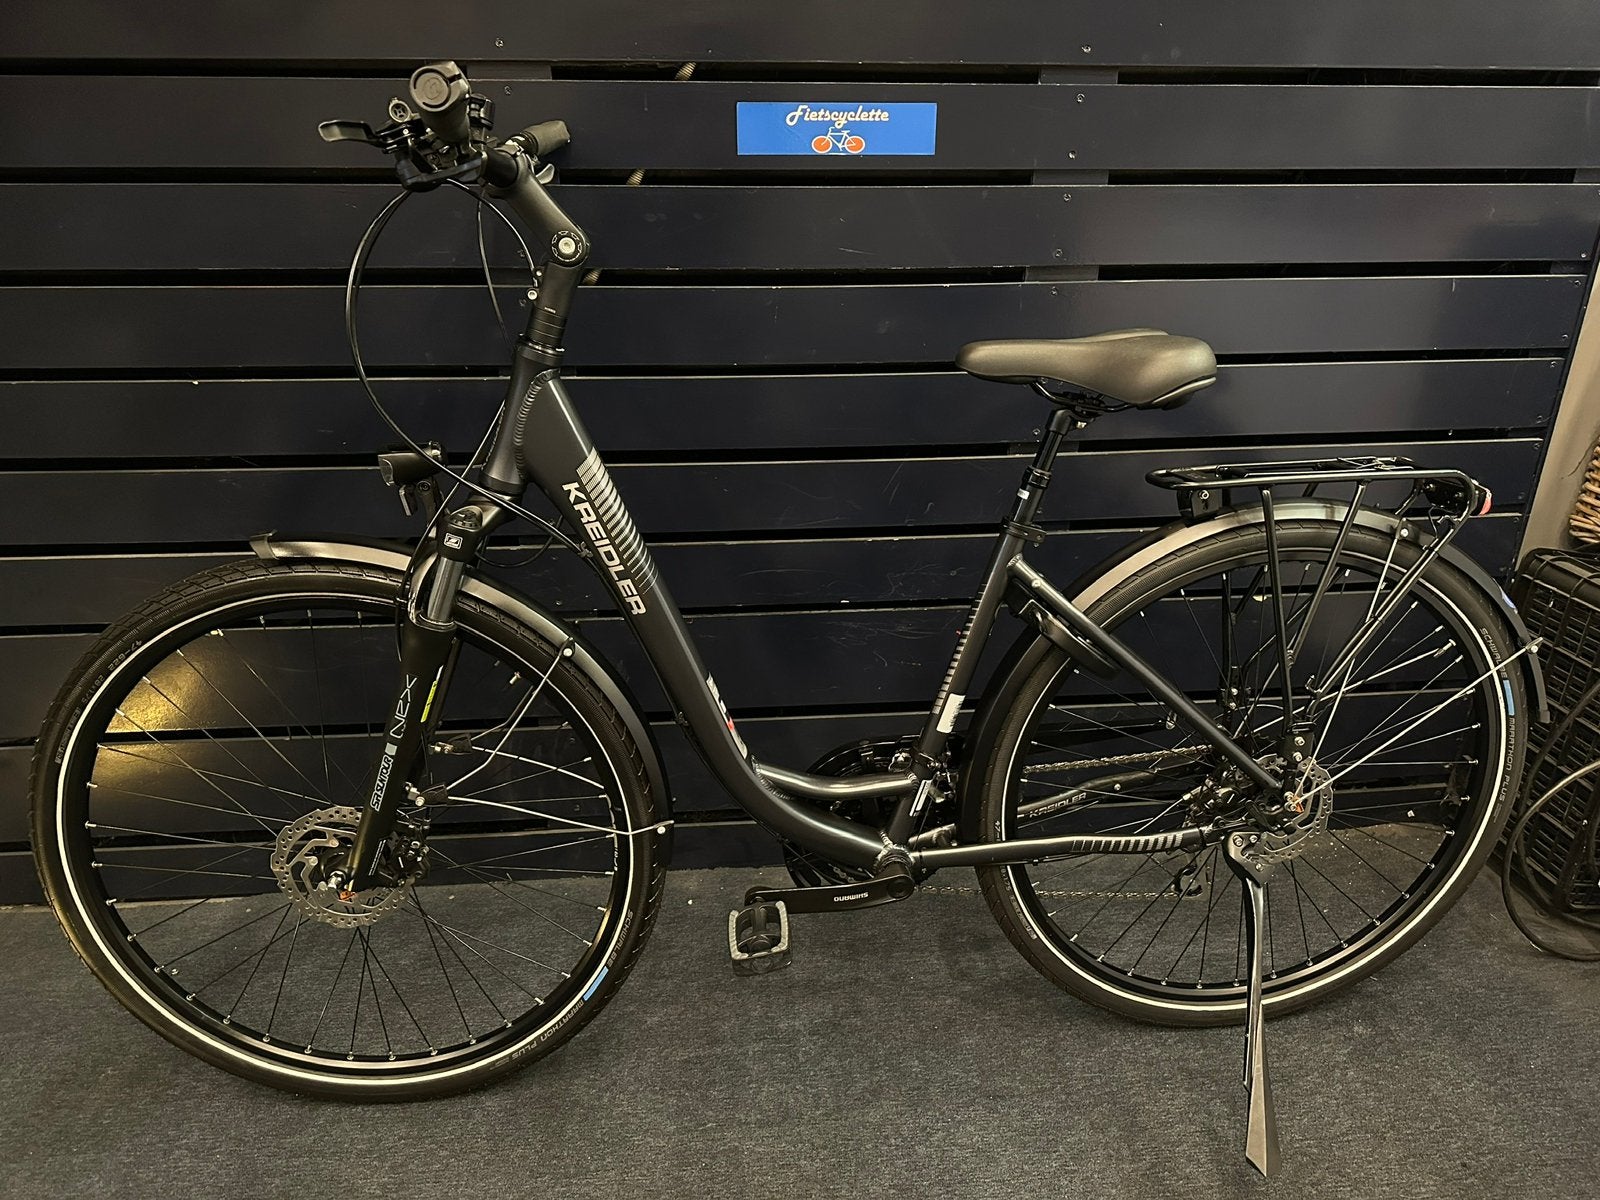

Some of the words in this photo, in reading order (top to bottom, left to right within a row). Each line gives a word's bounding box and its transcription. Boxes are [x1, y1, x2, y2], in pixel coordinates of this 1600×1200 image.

[786, 105, 890, 129] Fietscyclette
[561, 481, 647, 616] KREIDLER
[1498, 775, 1511, 802] PLUS
[834, 892, 868, 902] SHIMANO
[606, 909, 634, 967] SCHWALBE
[540, 999, 585, 1042] MARATHON
[511, 1041, 538, 1060] PLUS
